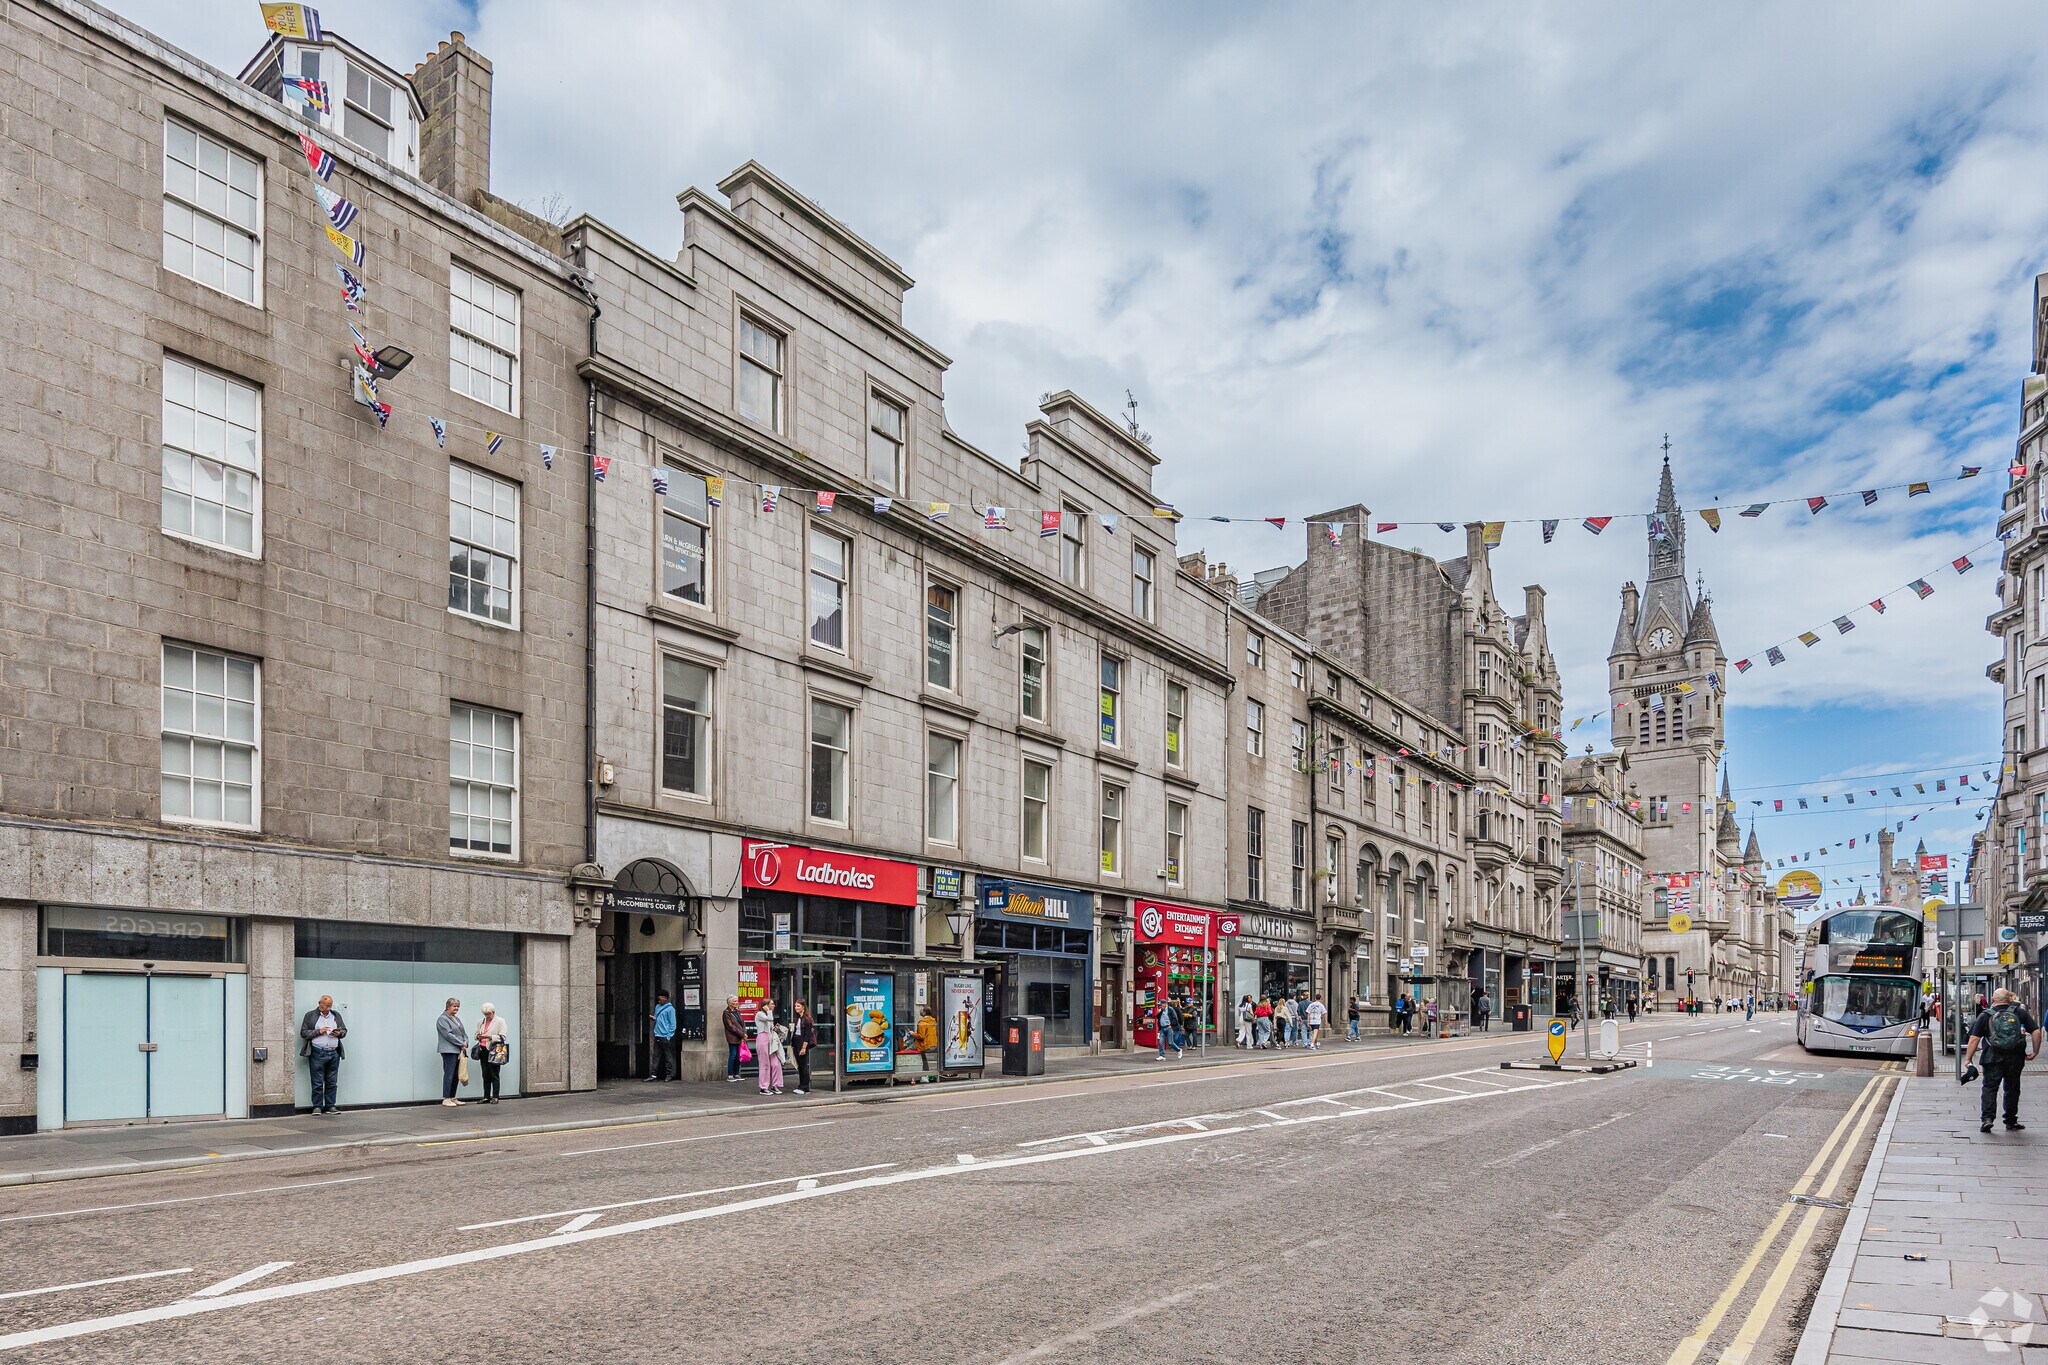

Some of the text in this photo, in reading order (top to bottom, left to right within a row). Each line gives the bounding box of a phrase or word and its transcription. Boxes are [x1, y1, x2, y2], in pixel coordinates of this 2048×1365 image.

[268, 15, 278, 29] SEA
[277, 14, 288, 31] YOU
[286, 6, 298, 33] THERE
[797, 859, 875, 890] Ladbrokes
[937, 876, 946, 884] TO
[617, 900, 655, 909] McCOMBIE'S
[989, 897, 1004, 906] HILL
[1045, 898, 1069, 919] HILL
[1175, 924, 1203, 935] EXCHANGE
[740, 972, 758, 983] MORE
[748, 988, 764, 998] CLUB
[864, 1002, 875, 1011] GET
[852, 1051, 870, 1062] £3.95
[1690, 1073, 1798, 1085] BUS
